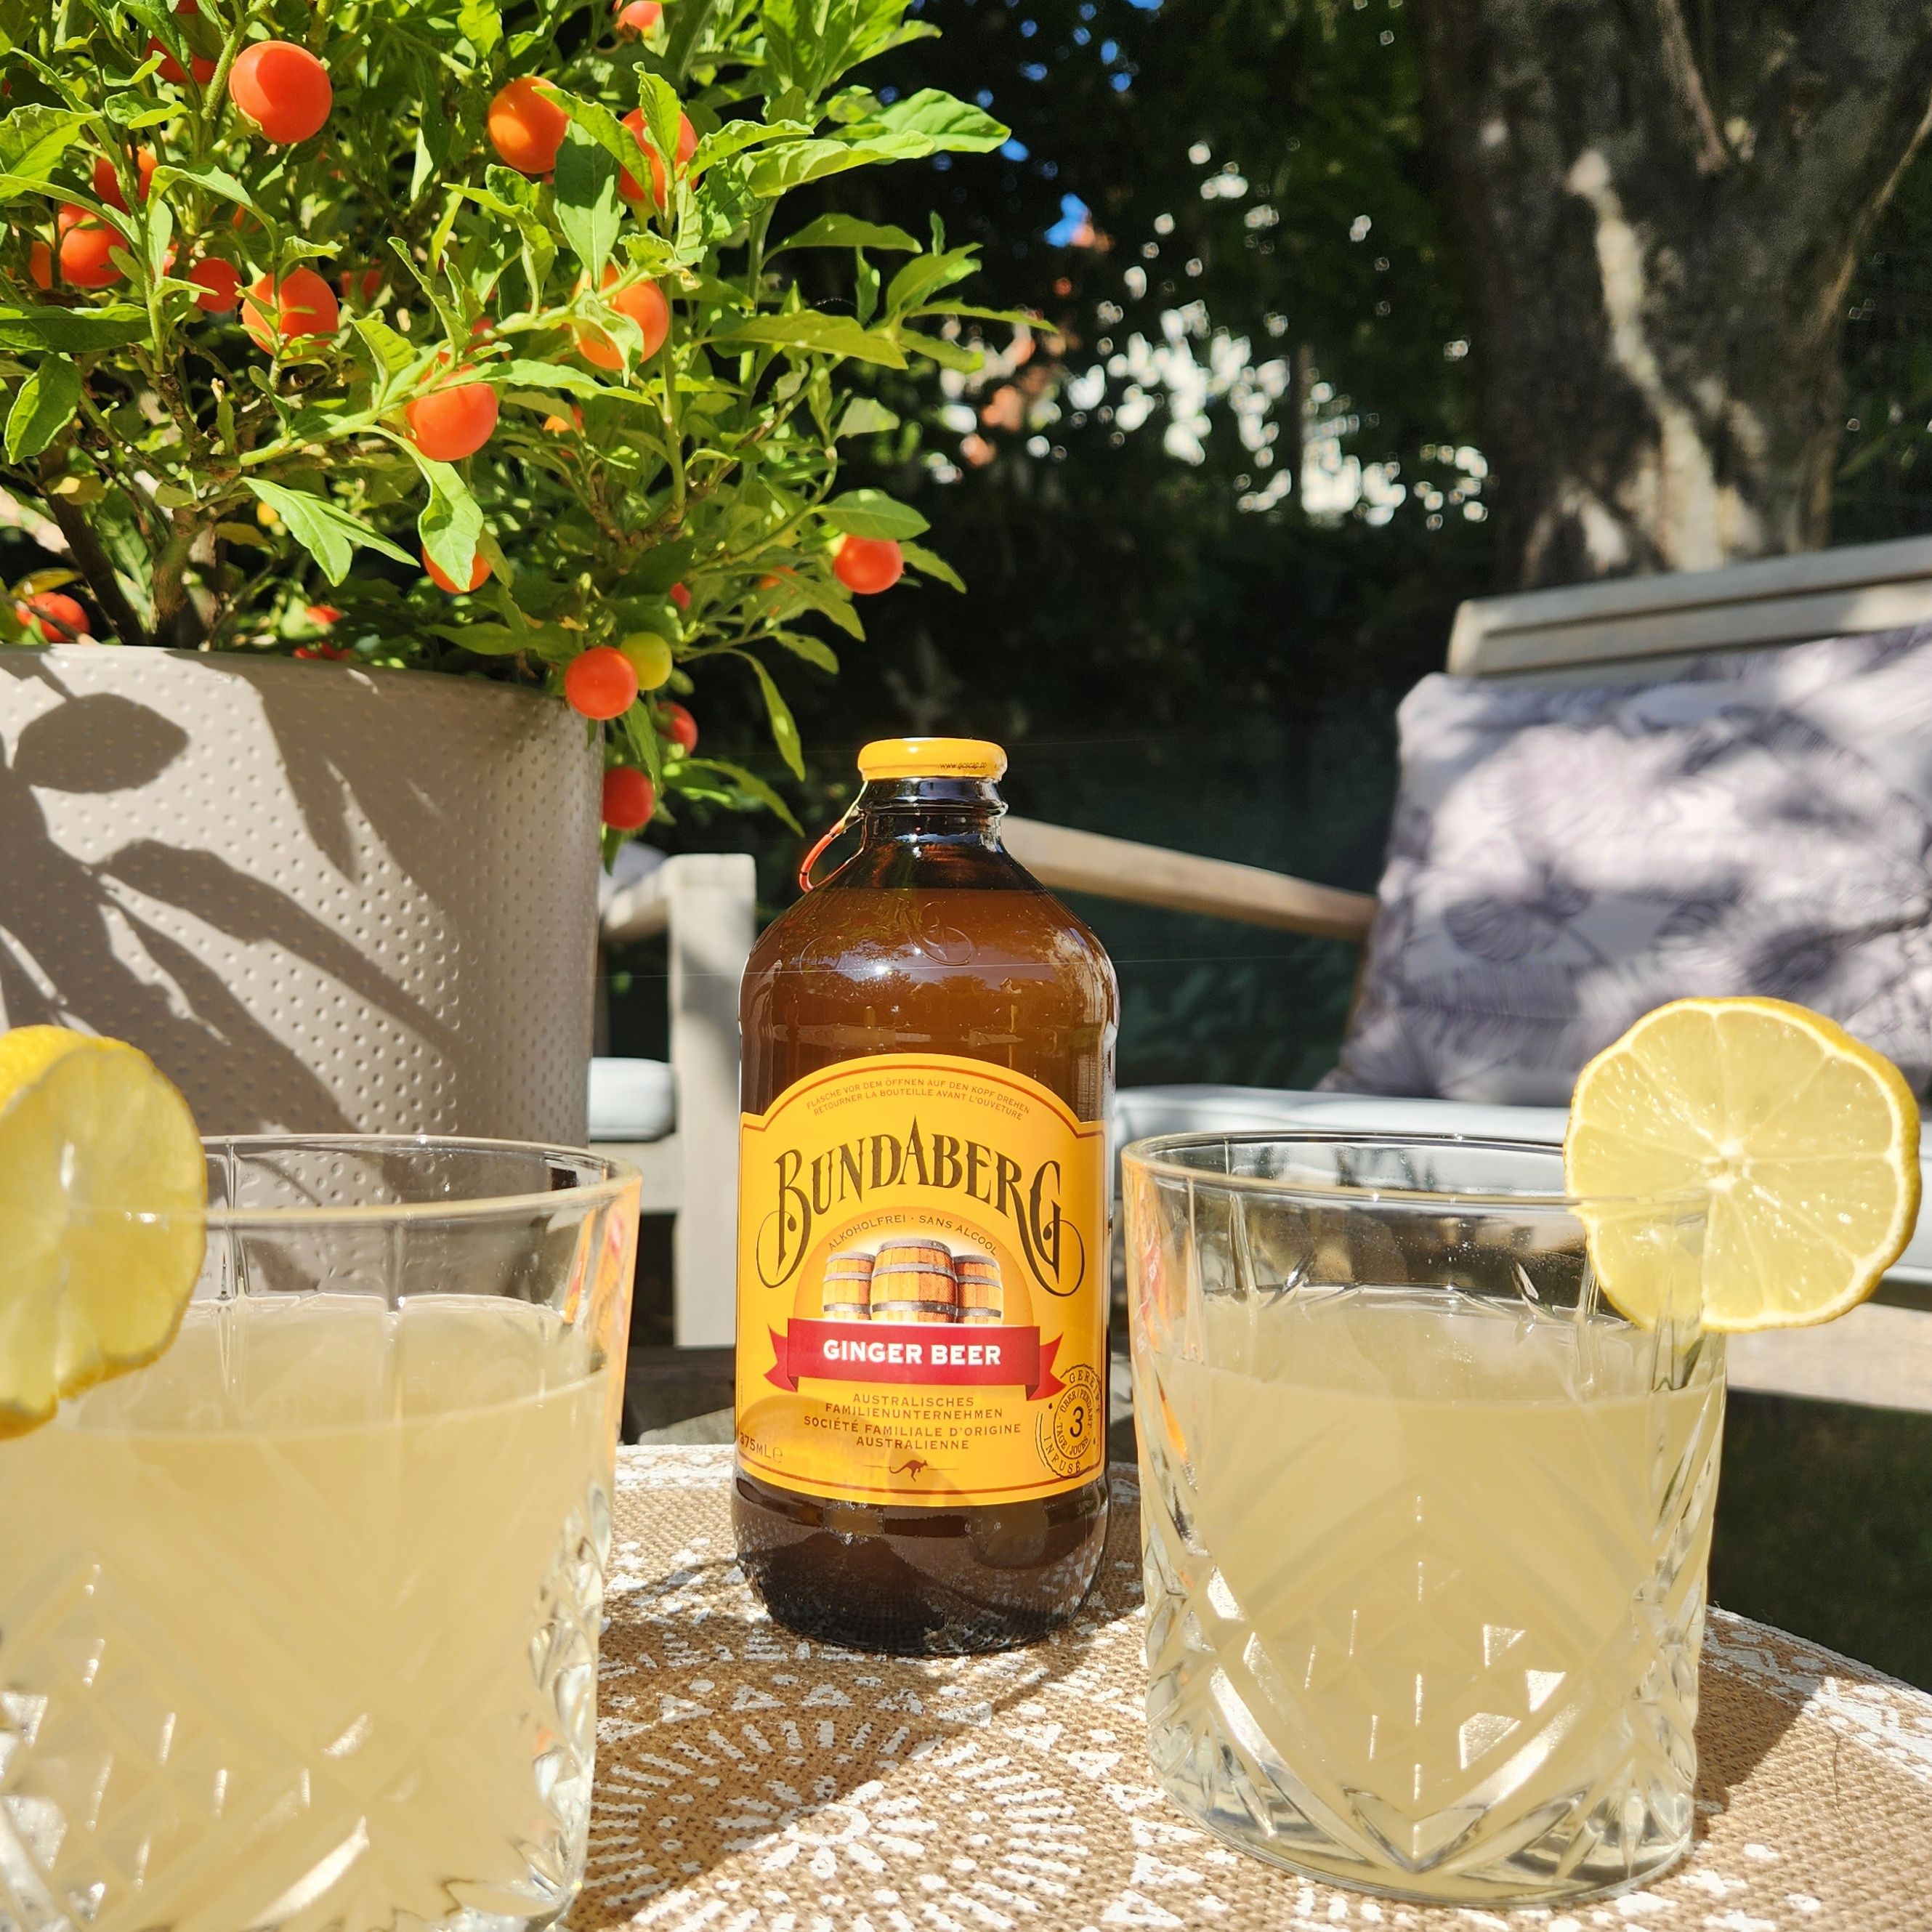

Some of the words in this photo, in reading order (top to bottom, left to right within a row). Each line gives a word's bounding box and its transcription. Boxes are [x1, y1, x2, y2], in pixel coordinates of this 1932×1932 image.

[807, 1089, 841, 1110] FLASCHE
[843, 1084, 860, 1094] VOR
[863, 1080, 882, 1090] DEM
[885, 1077, 924, 1086] ÖFFNEN
[927, 1079, 946, 1088] AUF
[949, 1081, 969, 1091] DEN
[971, 1086, 995, 1097] KOPF
[997, 1094, 1030, 1114] DREHEN
[814, 1094, 862, 1116] RETOURNER
[880, 1088, 934, 1097] BOUTEILLE
[936, 1091, 967, 1101] AVANT
[969, 1095, 1023, 1120] L'OUVETURE
[756, 1115, 1085, 1296] BUNDABERG
[828, 1214, 905, 1251] ALKOHOLFREI
[918, 1215, 953, 1229] SANS
[955, 1224, 998, 1256] ALCOOL
[823, 1339, 923, 1365] GINGER
[931, 1344, 1001, 1366] BEER
[825, 1402, 1003, 1420] FAMILIENUNTERNEHMEN
[853, 1393, 974, 1407] AUSTRALISCHES
[804, 1416, 859, 1432] SOCIÉTÉ
[865, 1424, 942, 1437] FAMILIALE
[950, 1423, 1021, 1437] D'ORIGINE
[1070, 1405, 1084, 1438] 3
[856, 1436, 969, 1450] AUSTRALIENNE
[1044, 1435, 1081, 1474] INFUSÉ
